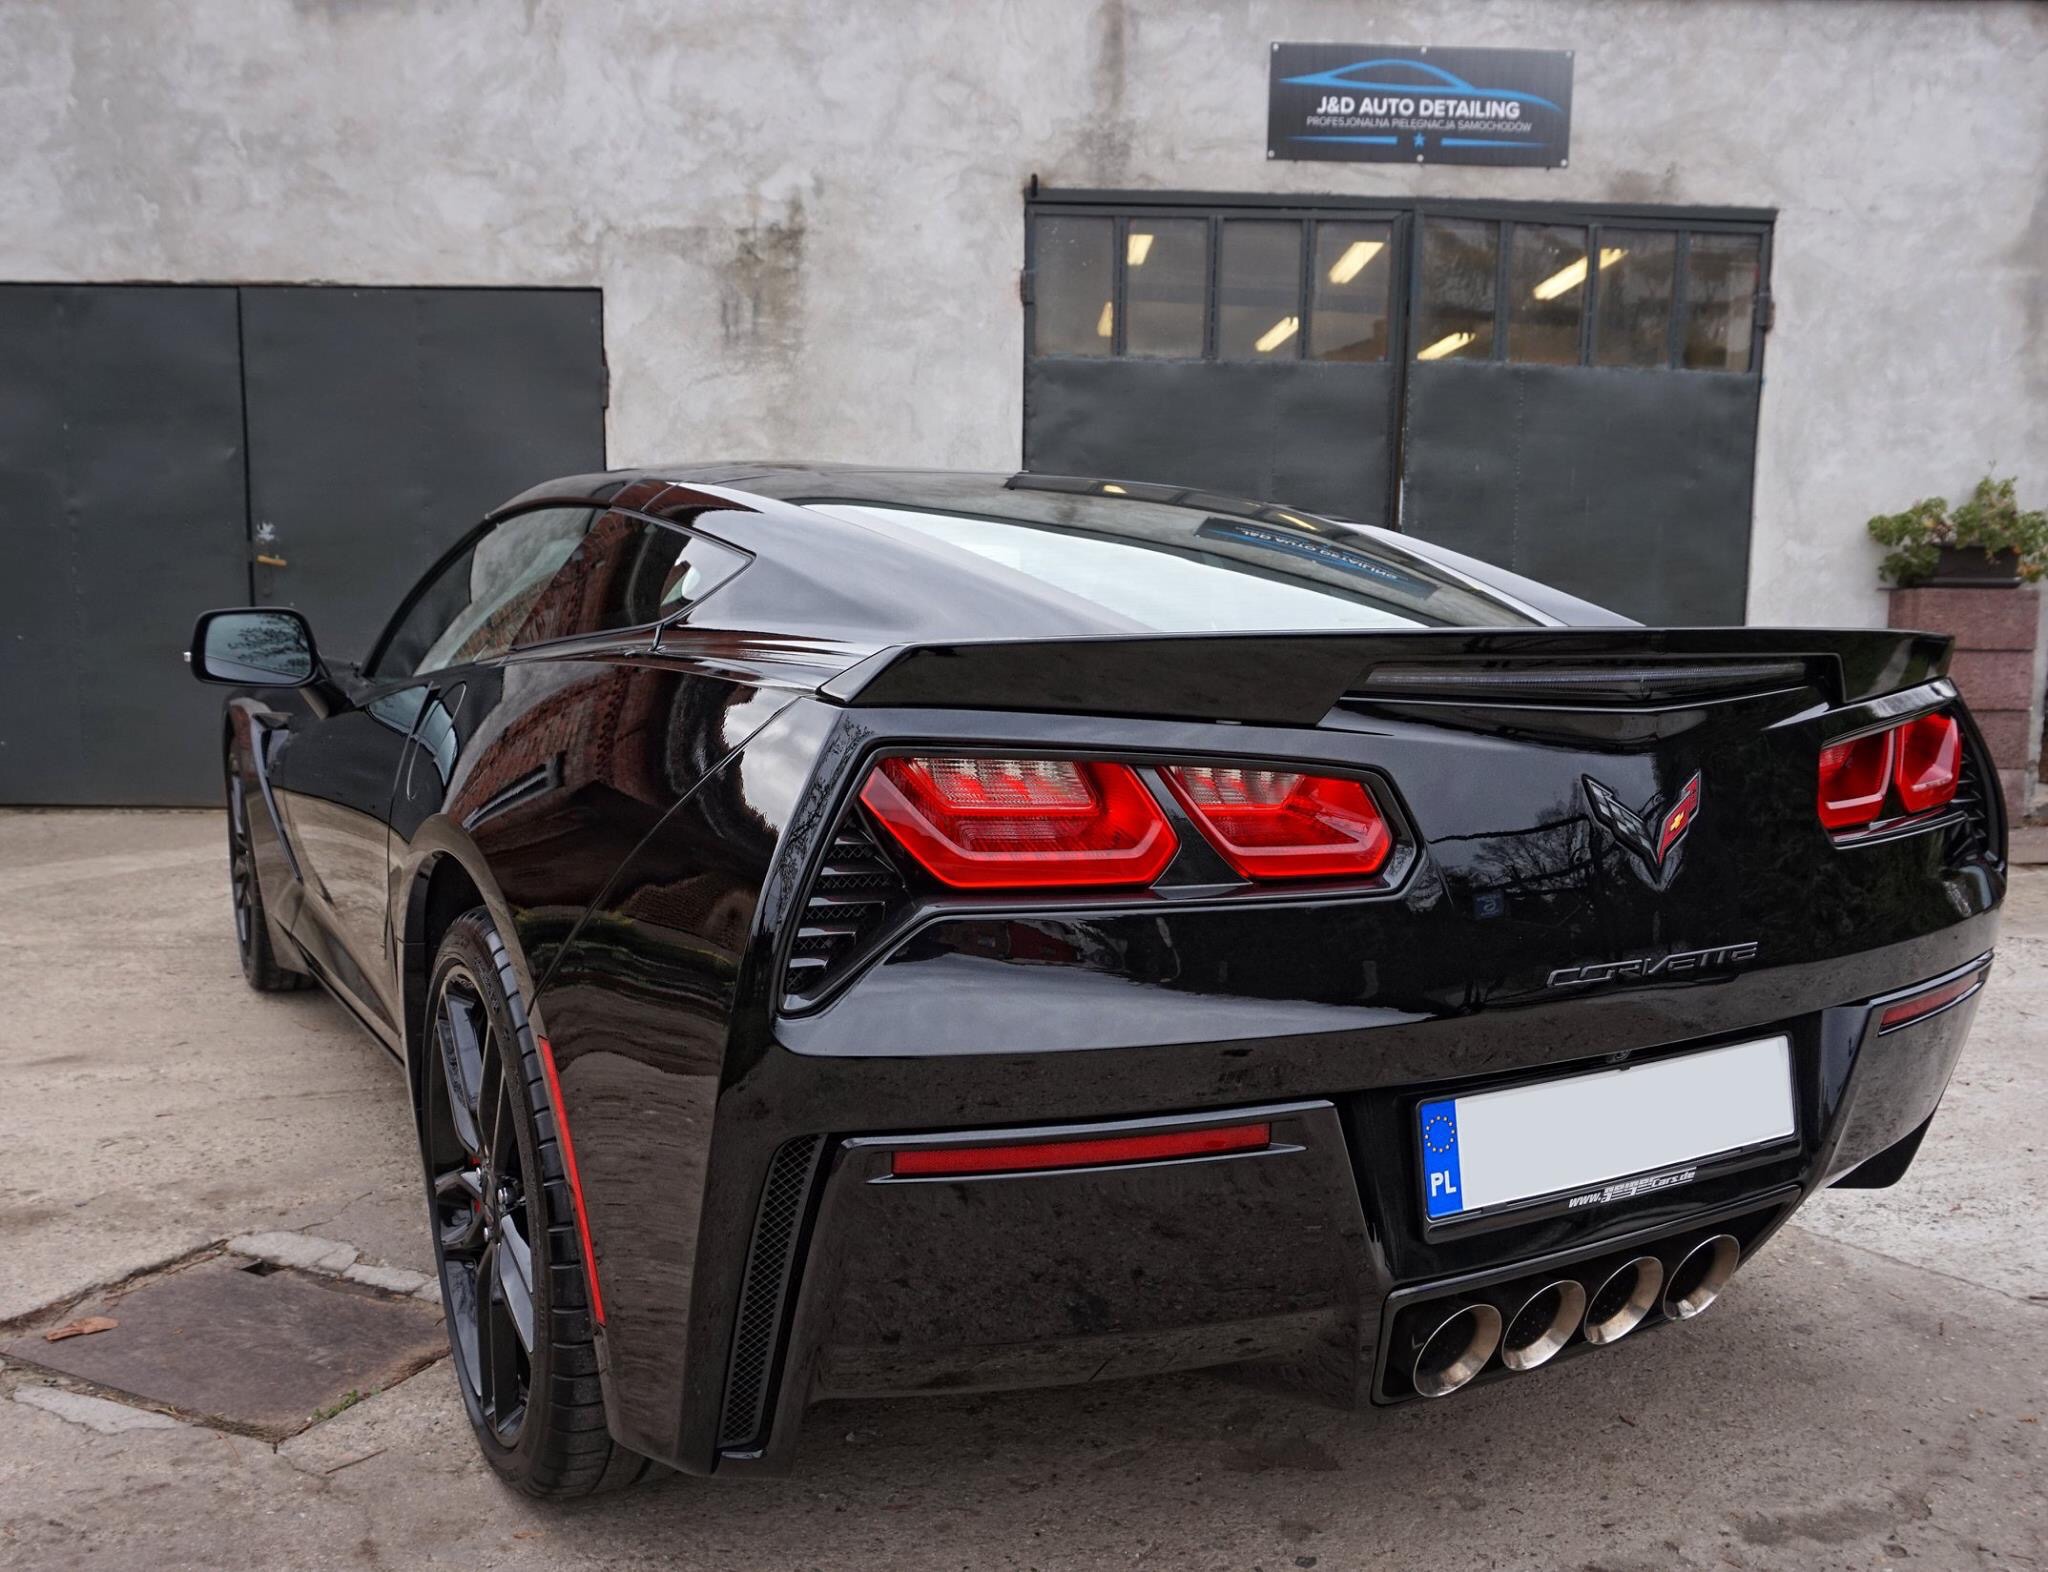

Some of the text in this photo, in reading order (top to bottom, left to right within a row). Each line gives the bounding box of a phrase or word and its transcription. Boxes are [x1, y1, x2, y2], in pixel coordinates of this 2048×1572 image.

[1316, 96, 1520, 118] J&D AUTO DETAILING
[1306, 116, 1390, 128] PROFESJONALNA
[1546, 941, 1758, 986] CORVETTE
[1430, 1169, 1457, 1197] PL
